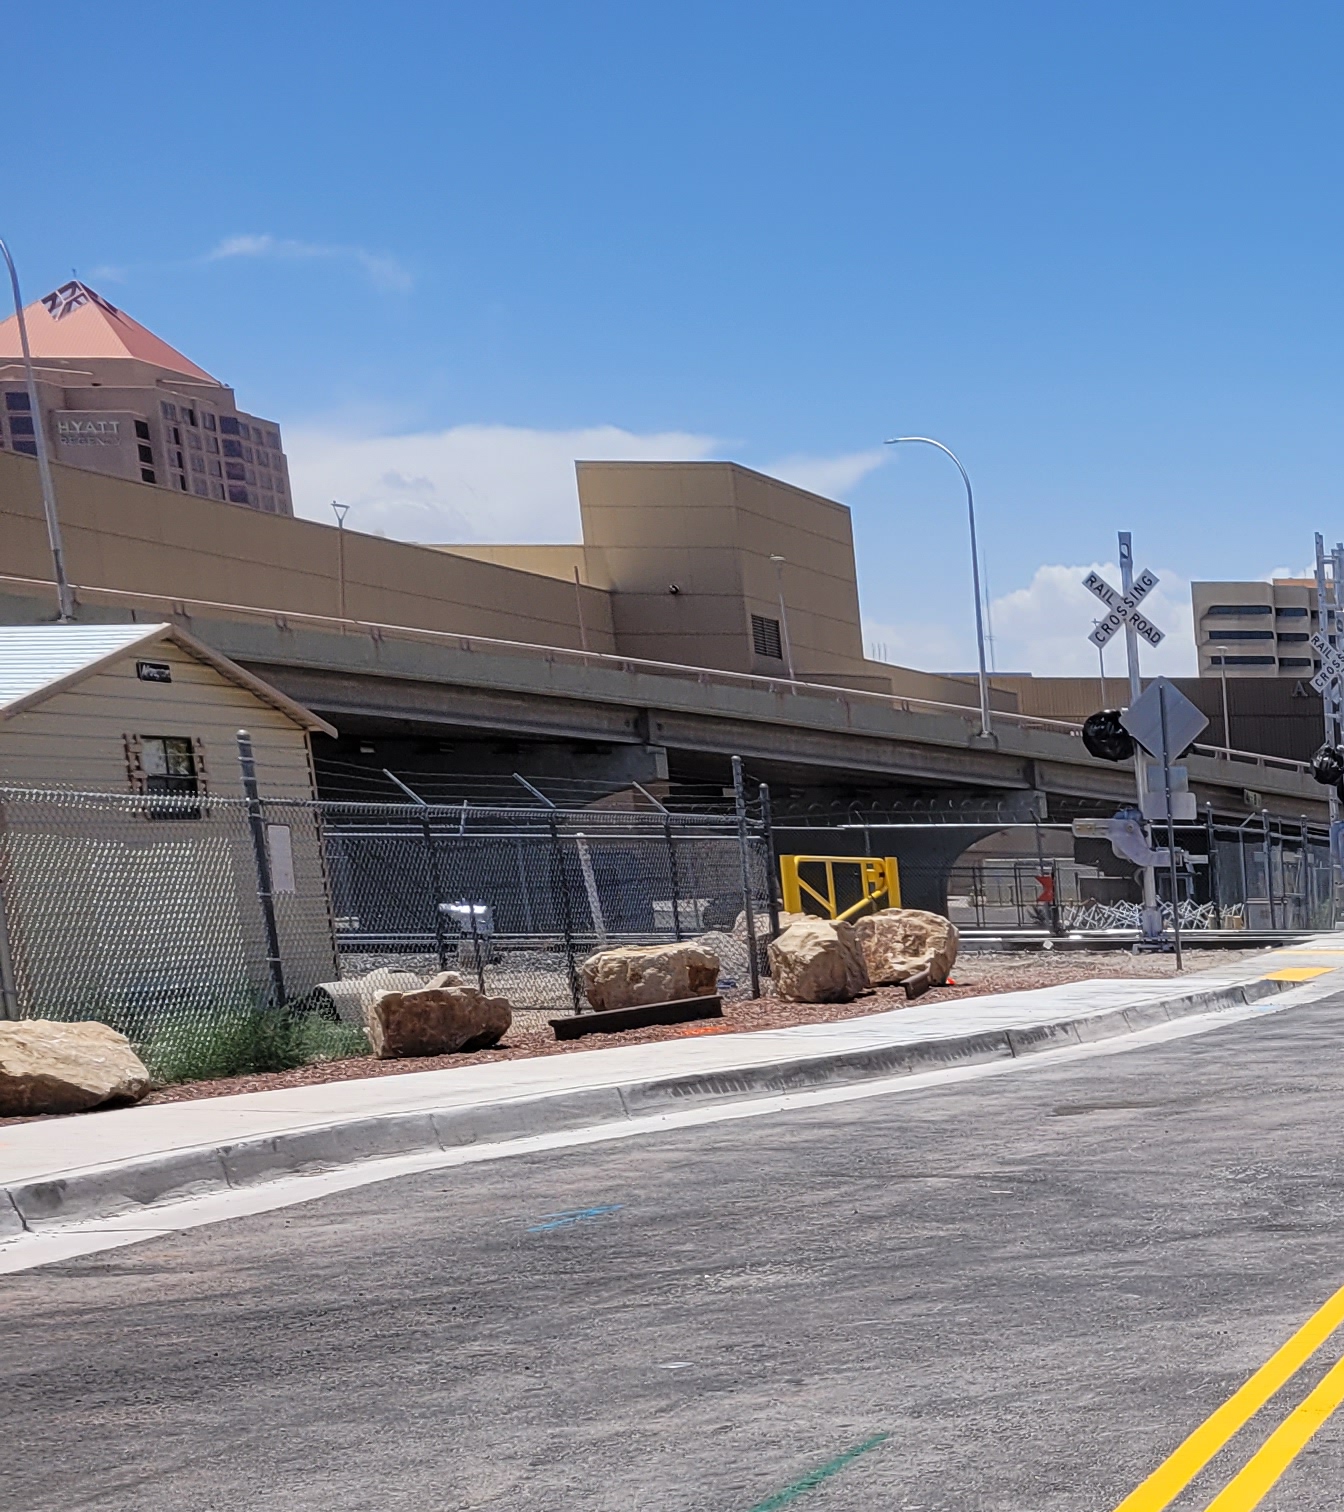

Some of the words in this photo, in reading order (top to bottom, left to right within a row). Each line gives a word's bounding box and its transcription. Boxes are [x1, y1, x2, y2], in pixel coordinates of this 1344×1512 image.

[57, 420, 120, 434] HYATT
[1085, 574, 1114, 606] RAIL
[1129, 613, 1161, 644] ROAD
[1094, 575, 1153, 643] CROSSING
[1311, 635, 1333, 659] RAIL
